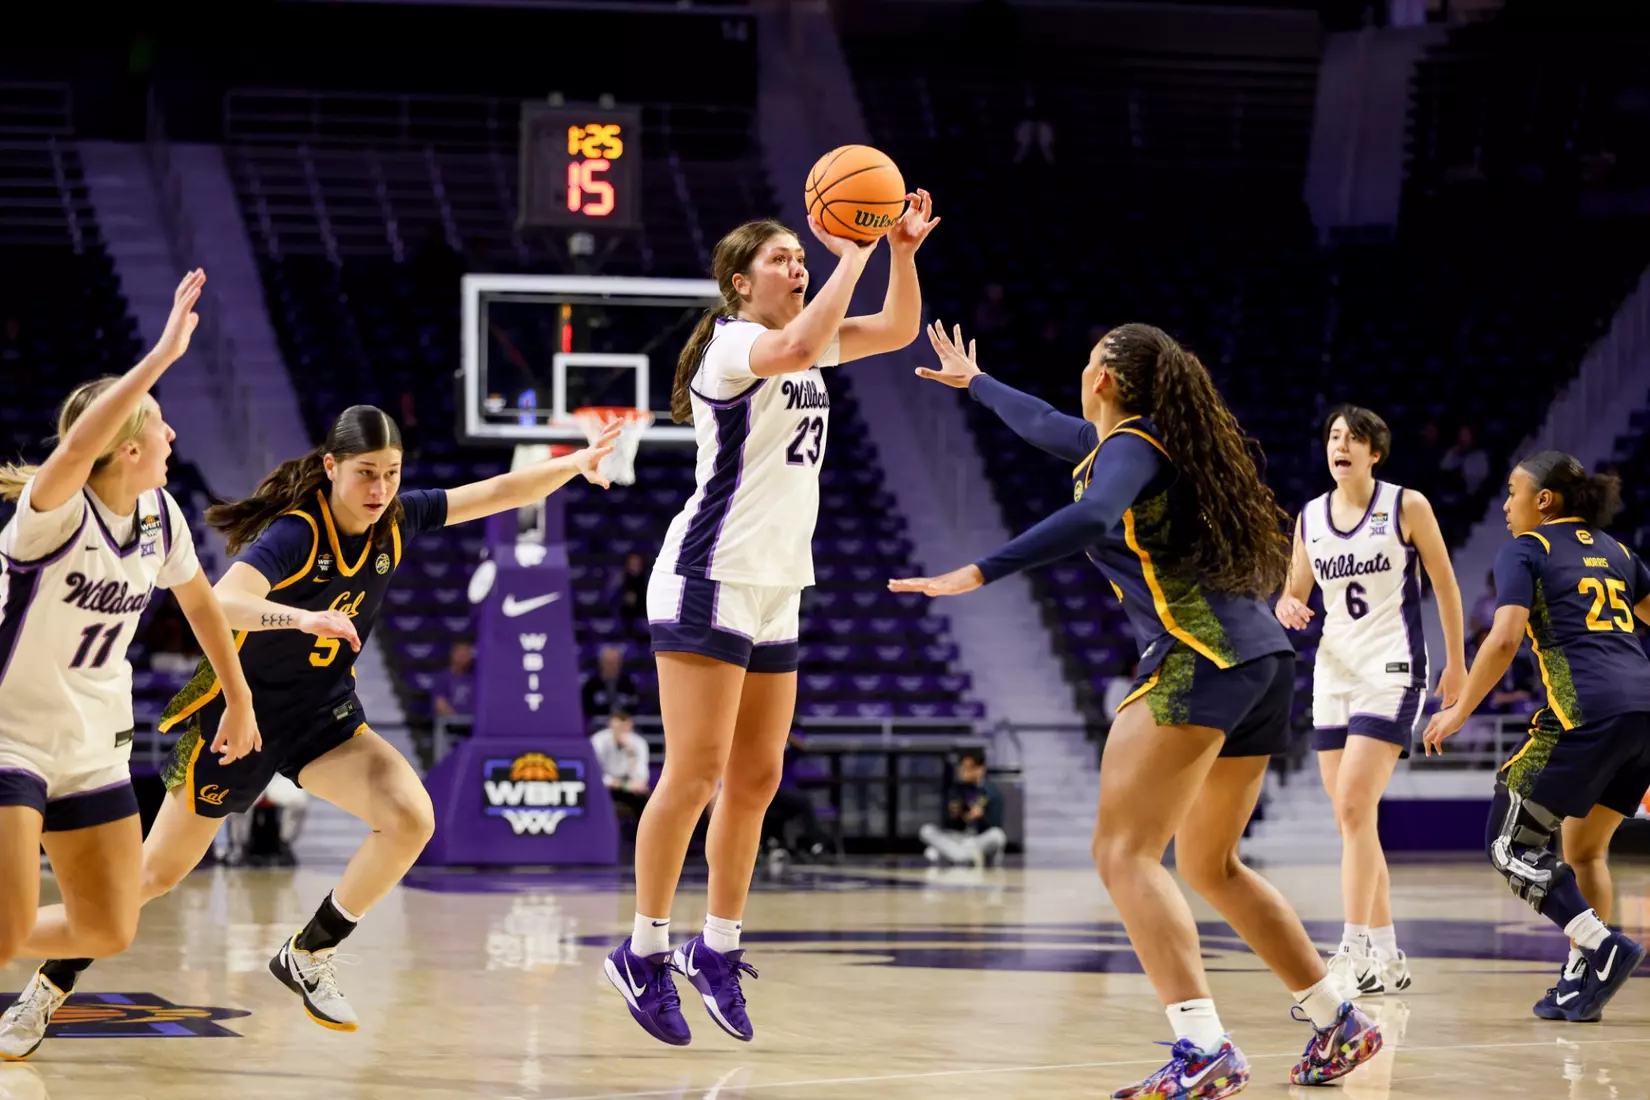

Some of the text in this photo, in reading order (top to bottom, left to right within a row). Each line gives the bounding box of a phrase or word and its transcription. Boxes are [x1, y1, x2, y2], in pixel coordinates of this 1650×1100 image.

[568, 124, 623, 159] 1:25
[568, 159, 614, 215] 15
[786, 415, 824, 467] 23
[1315, 552, 1391, 581] Wildcats
[1583, 557, 1608, 568] MORRIS
[327, 591, 366, 619] Cal
[1345, 581, 1369, 620] 6
[1578, 577, 1634, 633] 25
[69, 621, 124, 668] 11
[309, 635, 340, 667] 5
[199, 784, 230, 805] Cal
[484, 780, 586, 806] WBIT
